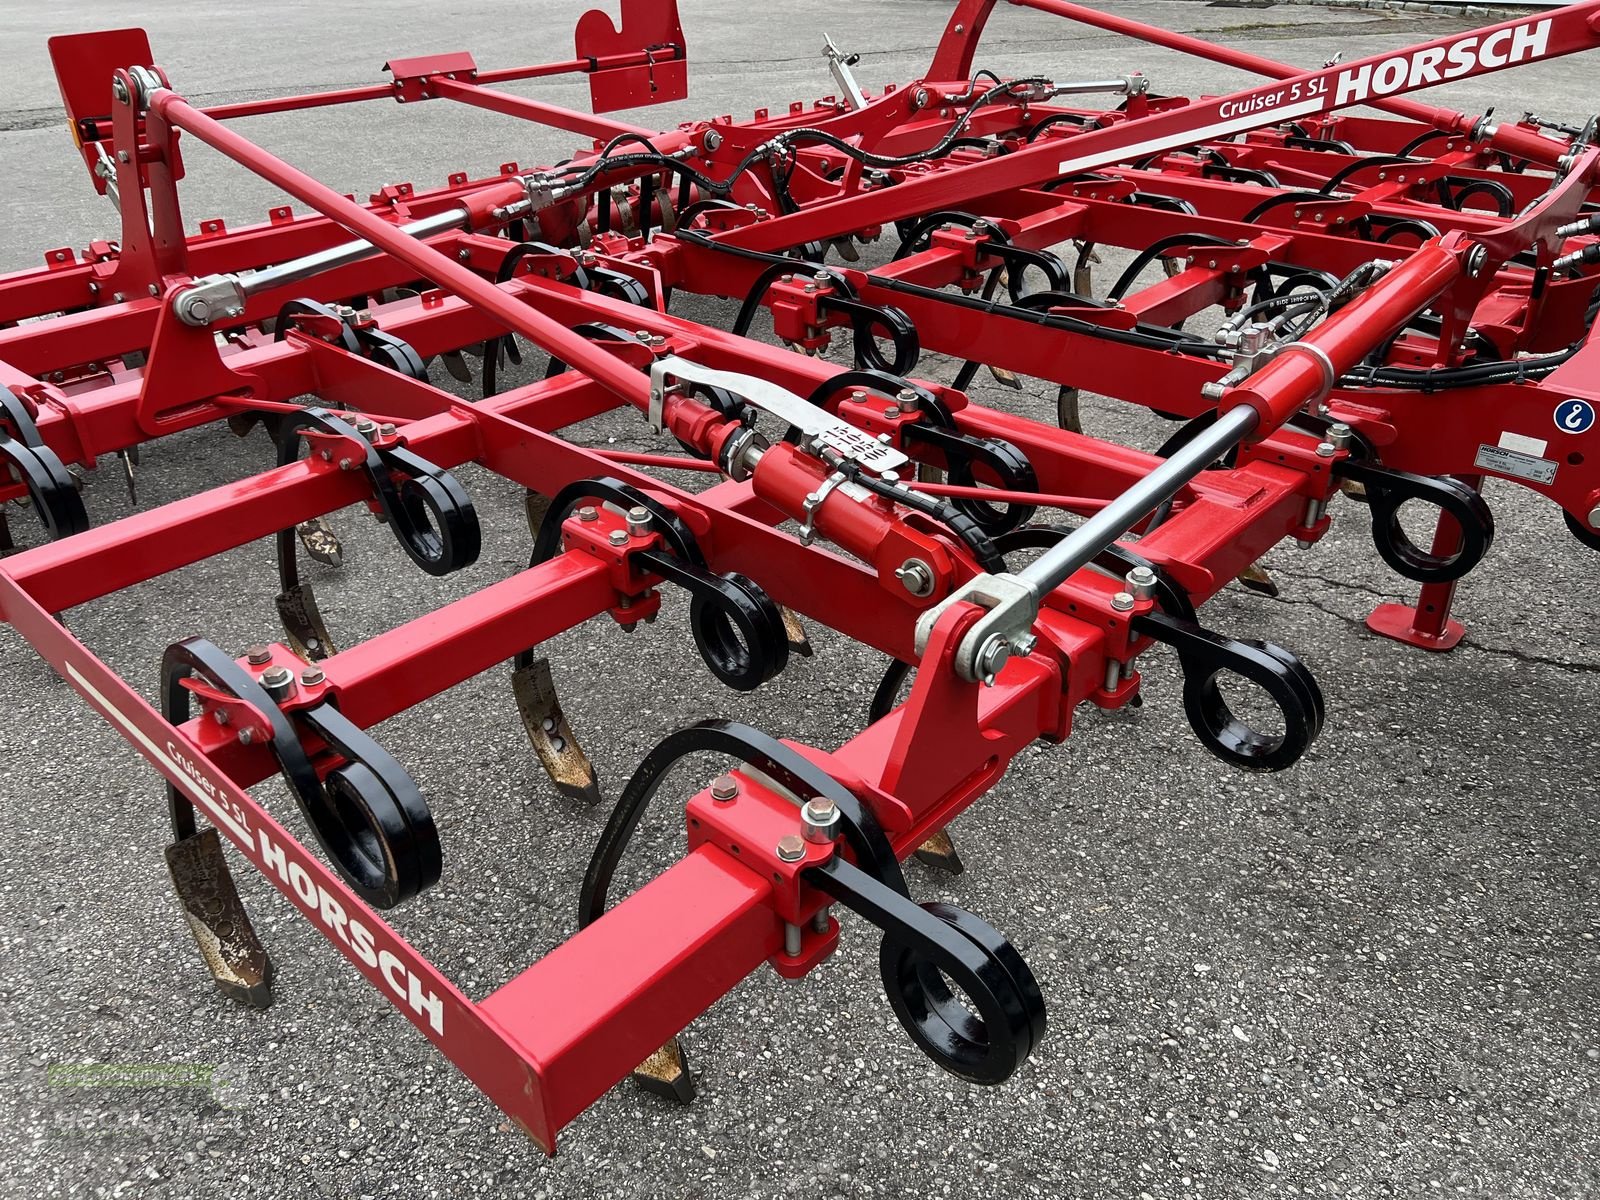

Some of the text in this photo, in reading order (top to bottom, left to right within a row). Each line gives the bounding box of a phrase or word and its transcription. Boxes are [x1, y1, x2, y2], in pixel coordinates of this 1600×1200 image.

[1219, 18, 1553, 120] Cruiser 5 SL HORSCH
[166, 740, 444, 1037] Cruiser 5 SL HORSCH
